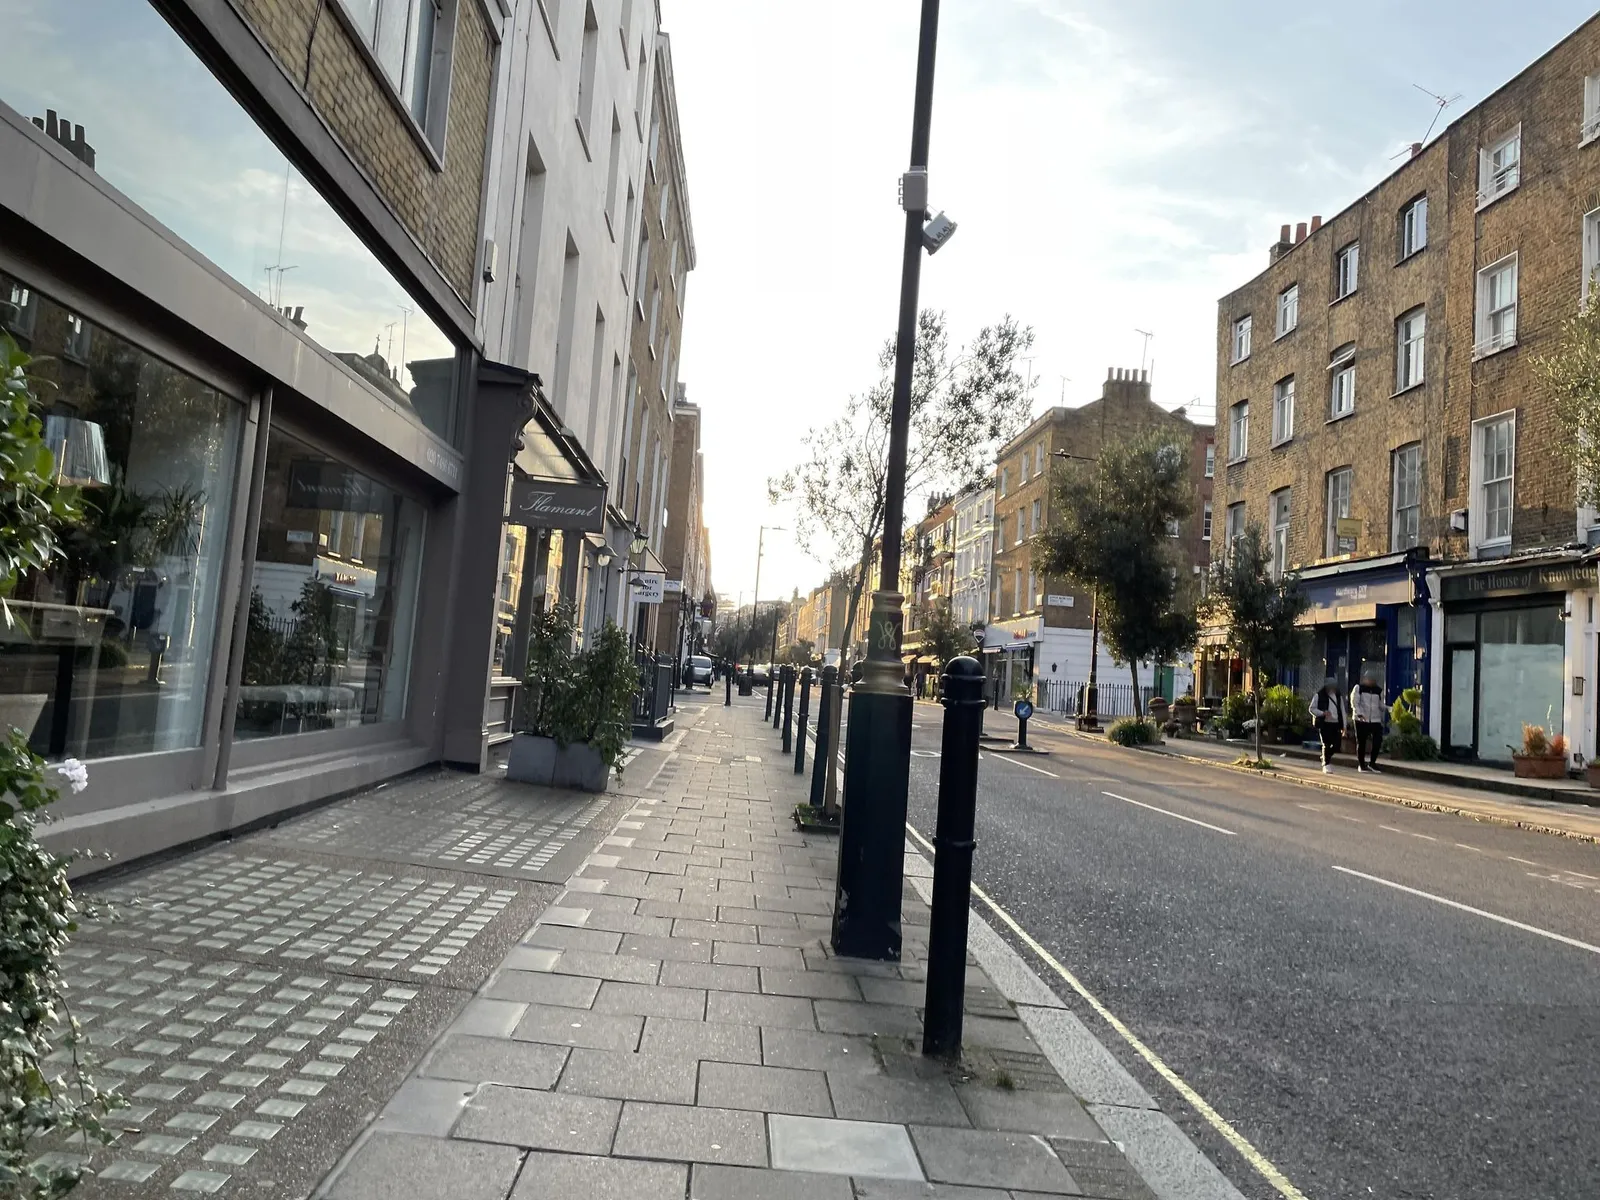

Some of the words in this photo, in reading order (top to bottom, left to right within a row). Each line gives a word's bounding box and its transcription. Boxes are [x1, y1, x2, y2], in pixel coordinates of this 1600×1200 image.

[519, 490, 597, 517] Flamant
[1468, 574, 1485, 591] The
[1487, 574, 1519, 589] House
[1521, 571, 1532, 588] of
[1539, 565, 1598, 584] Knowledg
